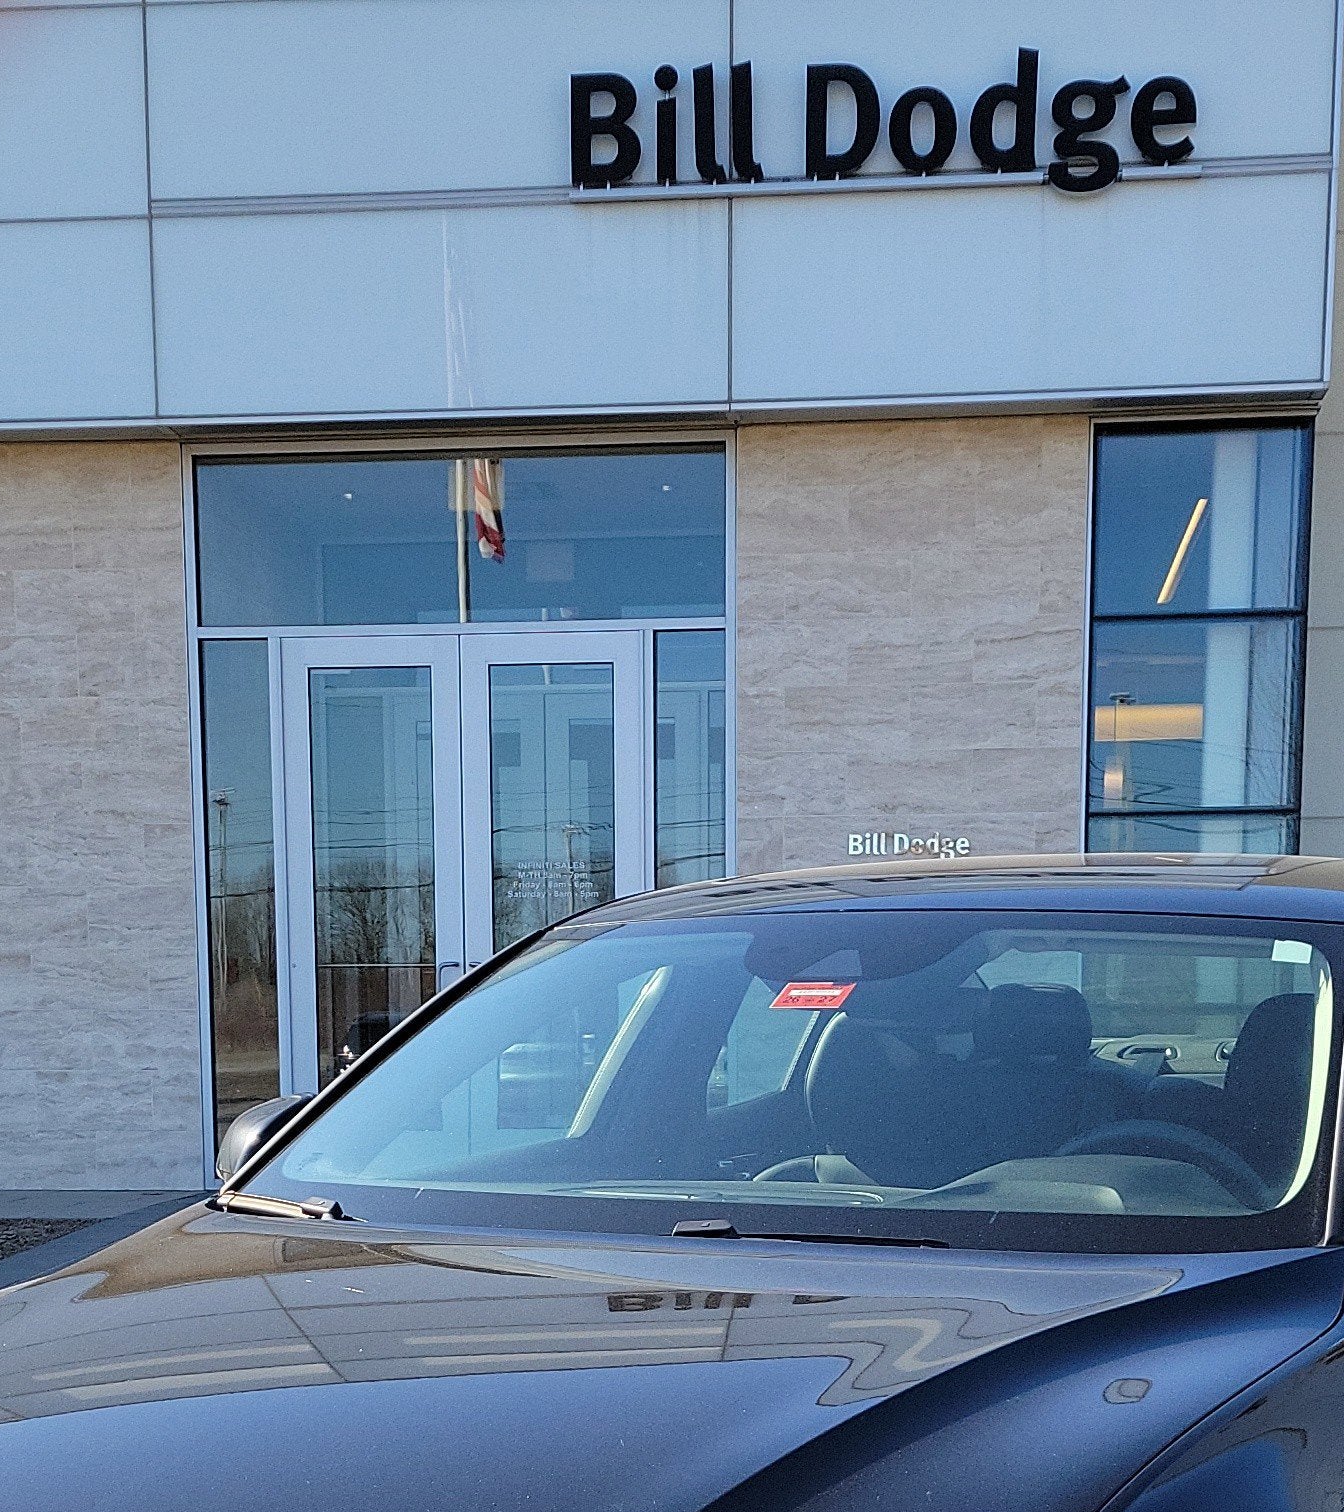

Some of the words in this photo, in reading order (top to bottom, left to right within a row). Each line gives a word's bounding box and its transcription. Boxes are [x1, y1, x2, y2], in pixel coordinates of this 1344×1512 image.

[570, 60, 763, 187] Bill
[805, 46, 1198, 194] Dodge
[848, 832, 888, 856] Bill
[893, 831, 971, 859] Dodge
[555, 861, 586, 869] SALES
[507, 890, 546, 899] Saturday
